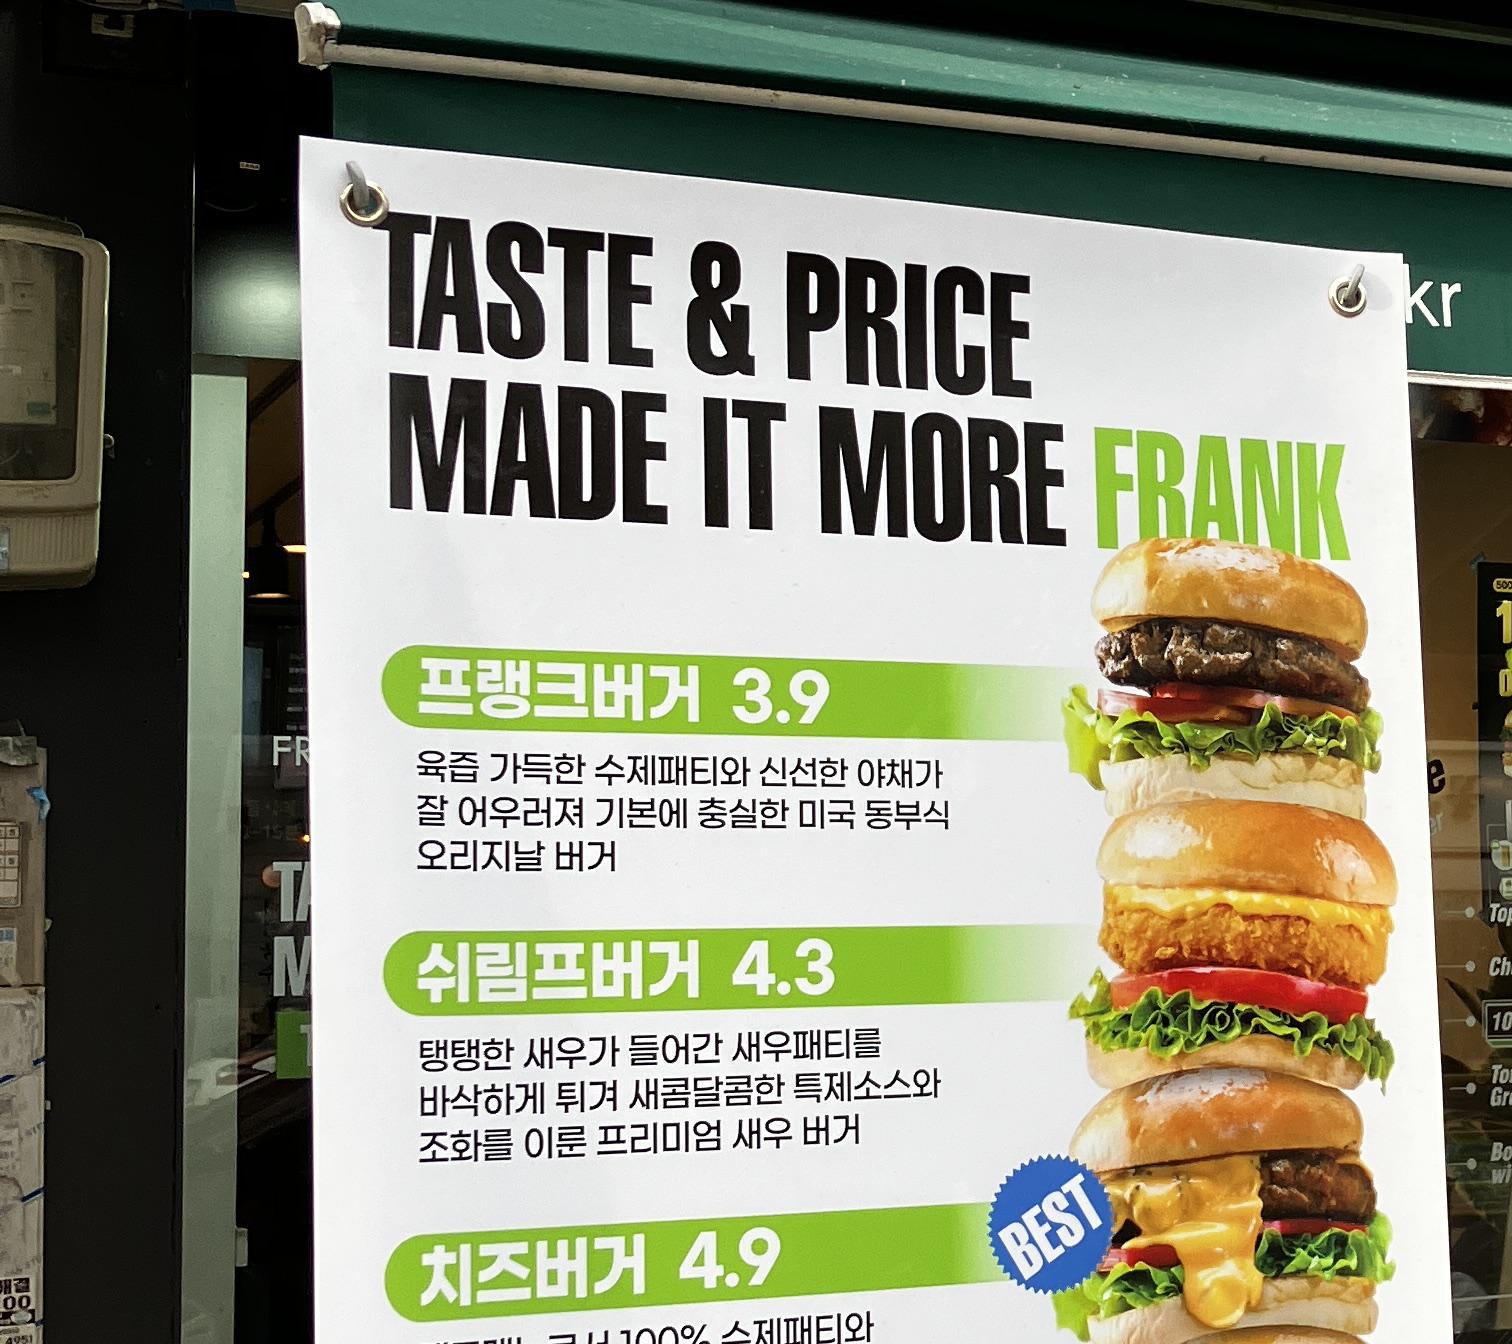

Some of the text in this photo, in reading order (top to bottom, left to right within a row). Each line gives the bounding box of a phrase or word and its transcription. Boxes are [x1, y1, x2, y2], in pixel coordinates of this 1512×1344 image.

[374, 212, 1032, 399] TASTE & PRICE
[388, 372, 1351, 560] MADE IT MORE FRANK
[417, 656, 830, 725] 프랭크버거 3.9
[416, 750, 943, 790] 육즙 가득한 수제패티와 신선한 야채가
[416, 795, 949, 831] 잘 어우러져 기본에 충실한 미국 동부식
[416, 839, 616, 873] 오리지날 버거
[417, 938, 835, 1004] 쉬림프버거 4.3
[419, 1028, 881, 1073] 탱탱한 새우가 들어간 새우패티를
[419, 1068, 941, 1117] 바삭하게 튀겨 새콤달콤한 특제소스와
[419, 1114, 860, 1164] 조화를 이룬 프리미엄 새우 버거
[998, 1172, 1103, 1281] BEST
[420, 1227, 781, 1308] 치즈버거 4.9
